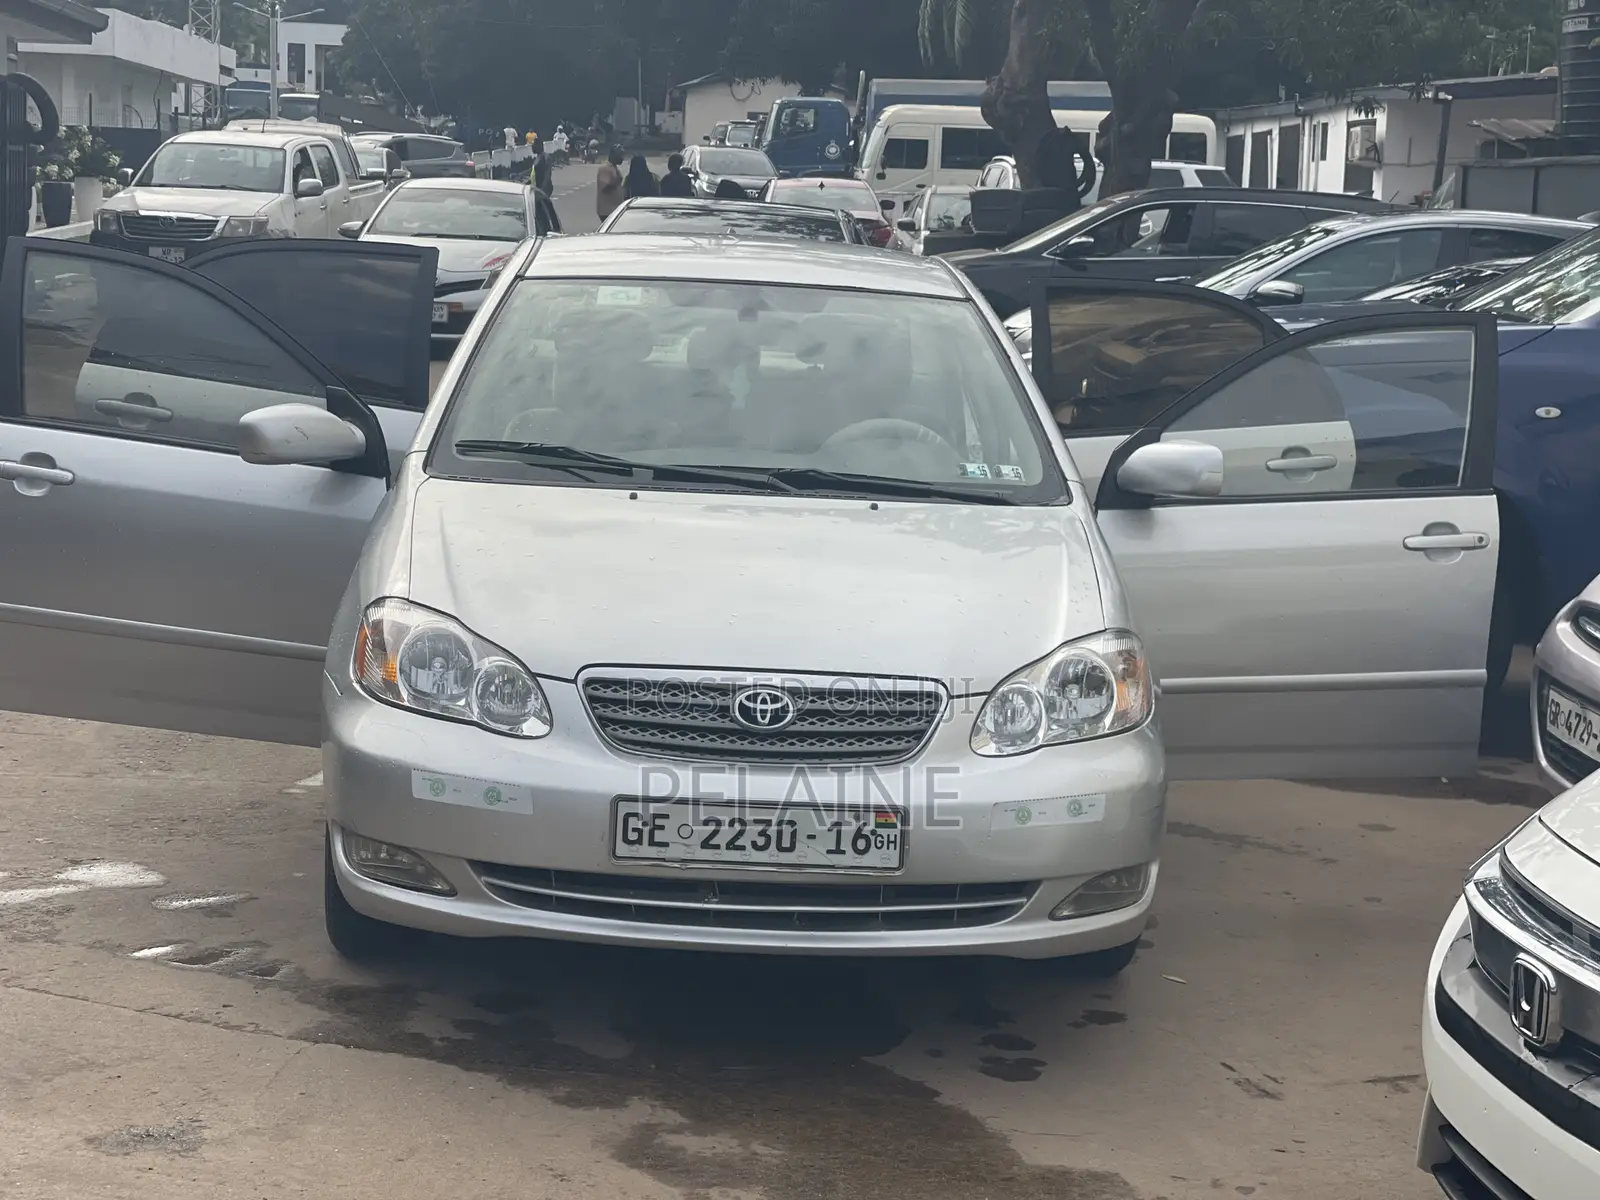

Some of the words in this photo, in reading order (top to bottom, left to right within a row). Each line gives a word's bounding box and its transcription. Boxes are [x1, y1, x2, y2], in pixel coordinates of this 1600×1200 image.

[1549, 699, 1560, 729] GR
[622, 812, 670, 847] GE
[874, 833, 898, 851] GH
